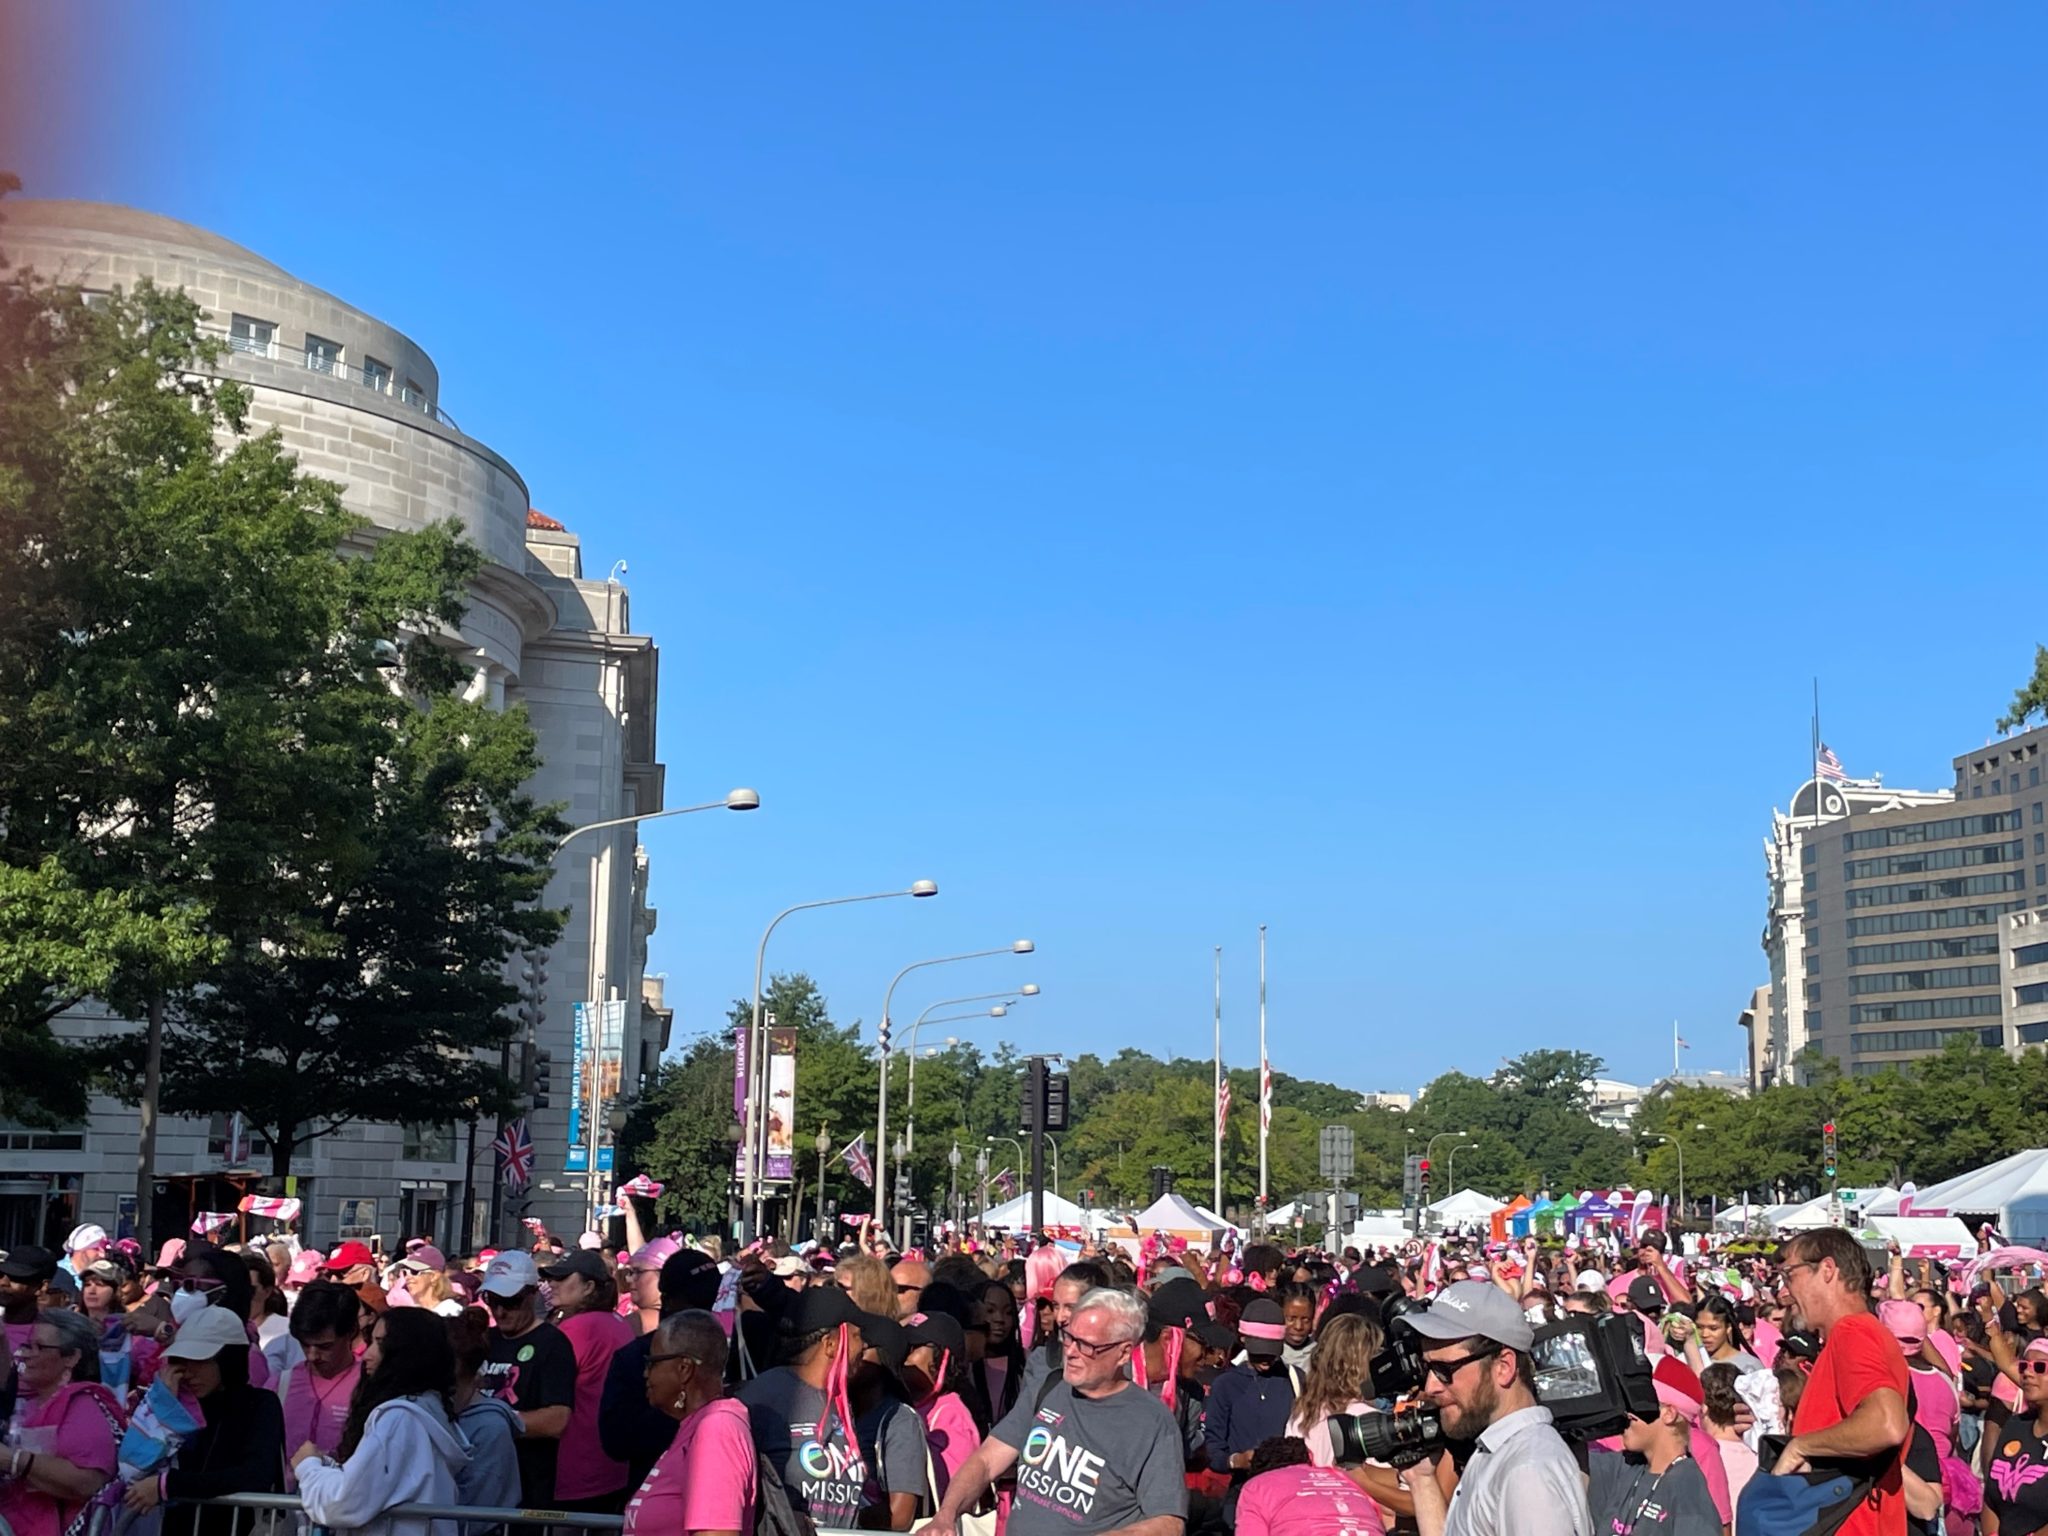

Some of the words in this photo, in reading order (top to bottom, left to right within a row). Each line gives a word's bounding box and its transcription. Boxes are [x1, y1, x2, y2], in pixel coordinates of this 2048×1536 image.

[574, 1009, 582, 1044] CENTER
[571, 1076, 579, 1110] WORLD
[1023, 1427, 1106, 1496] ONE
